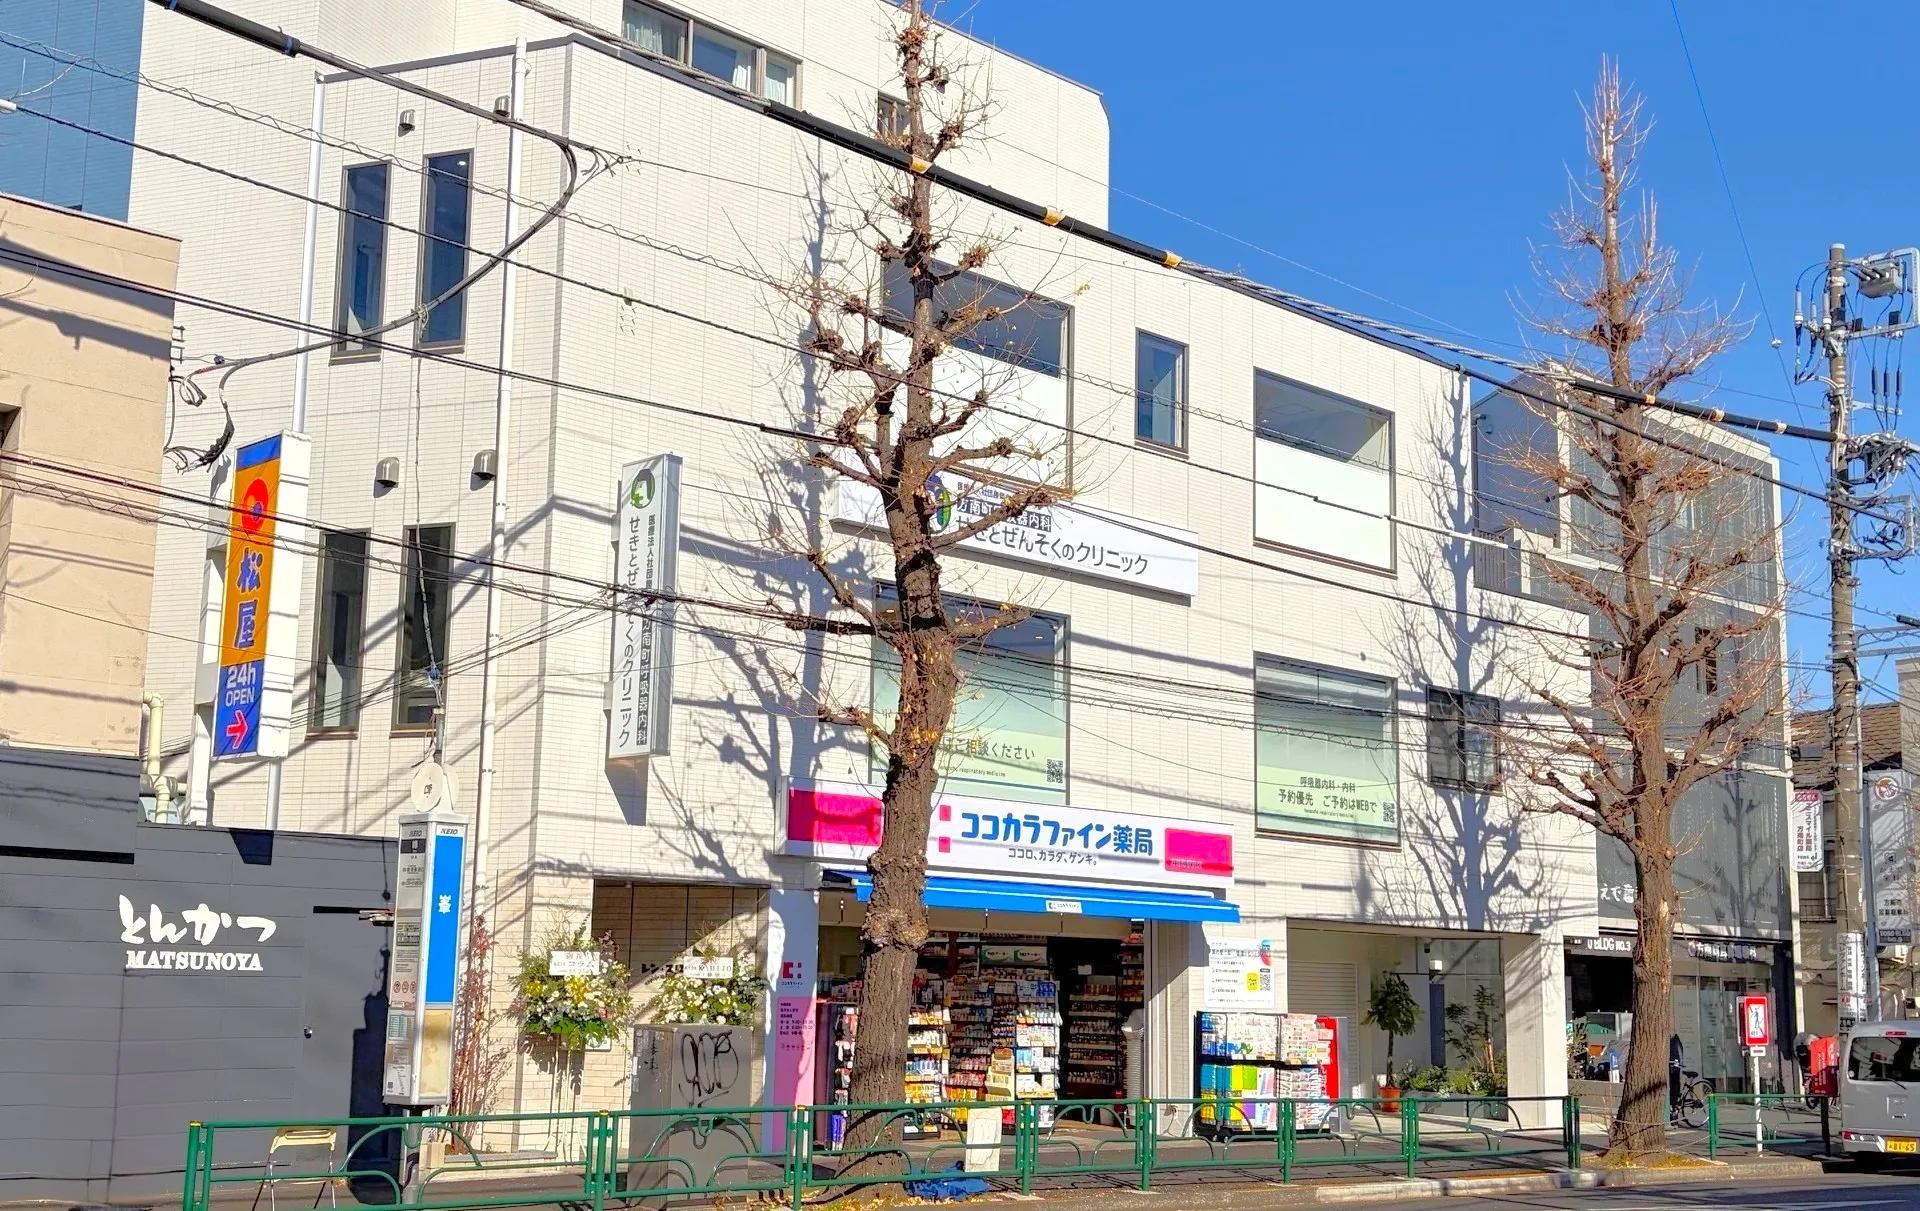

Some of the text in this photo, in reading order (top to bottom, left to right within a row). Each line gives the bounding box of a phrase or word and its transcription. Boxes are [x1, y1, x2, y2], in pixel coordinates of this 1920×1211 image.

[957, 498, 1051, 532] 方南町器内科
[235, 547, 264, 650] 松屋
[618, 516, 641, 748] せきとぜそくのクリニック
[225, 664, 256, 690] 24h
[225, 686, 255, 706] OPEN
[961, 812, 1153, 856] ココカラファイン薬局
[1008, 848, 1098, 866] ココロ、カラダ、ゲンキ。
[1600, 883, 1638, 904] えで歯
[118, 894, 277, 946] とんかつ
[125, 950, 264, 972] MATSUNOYA
